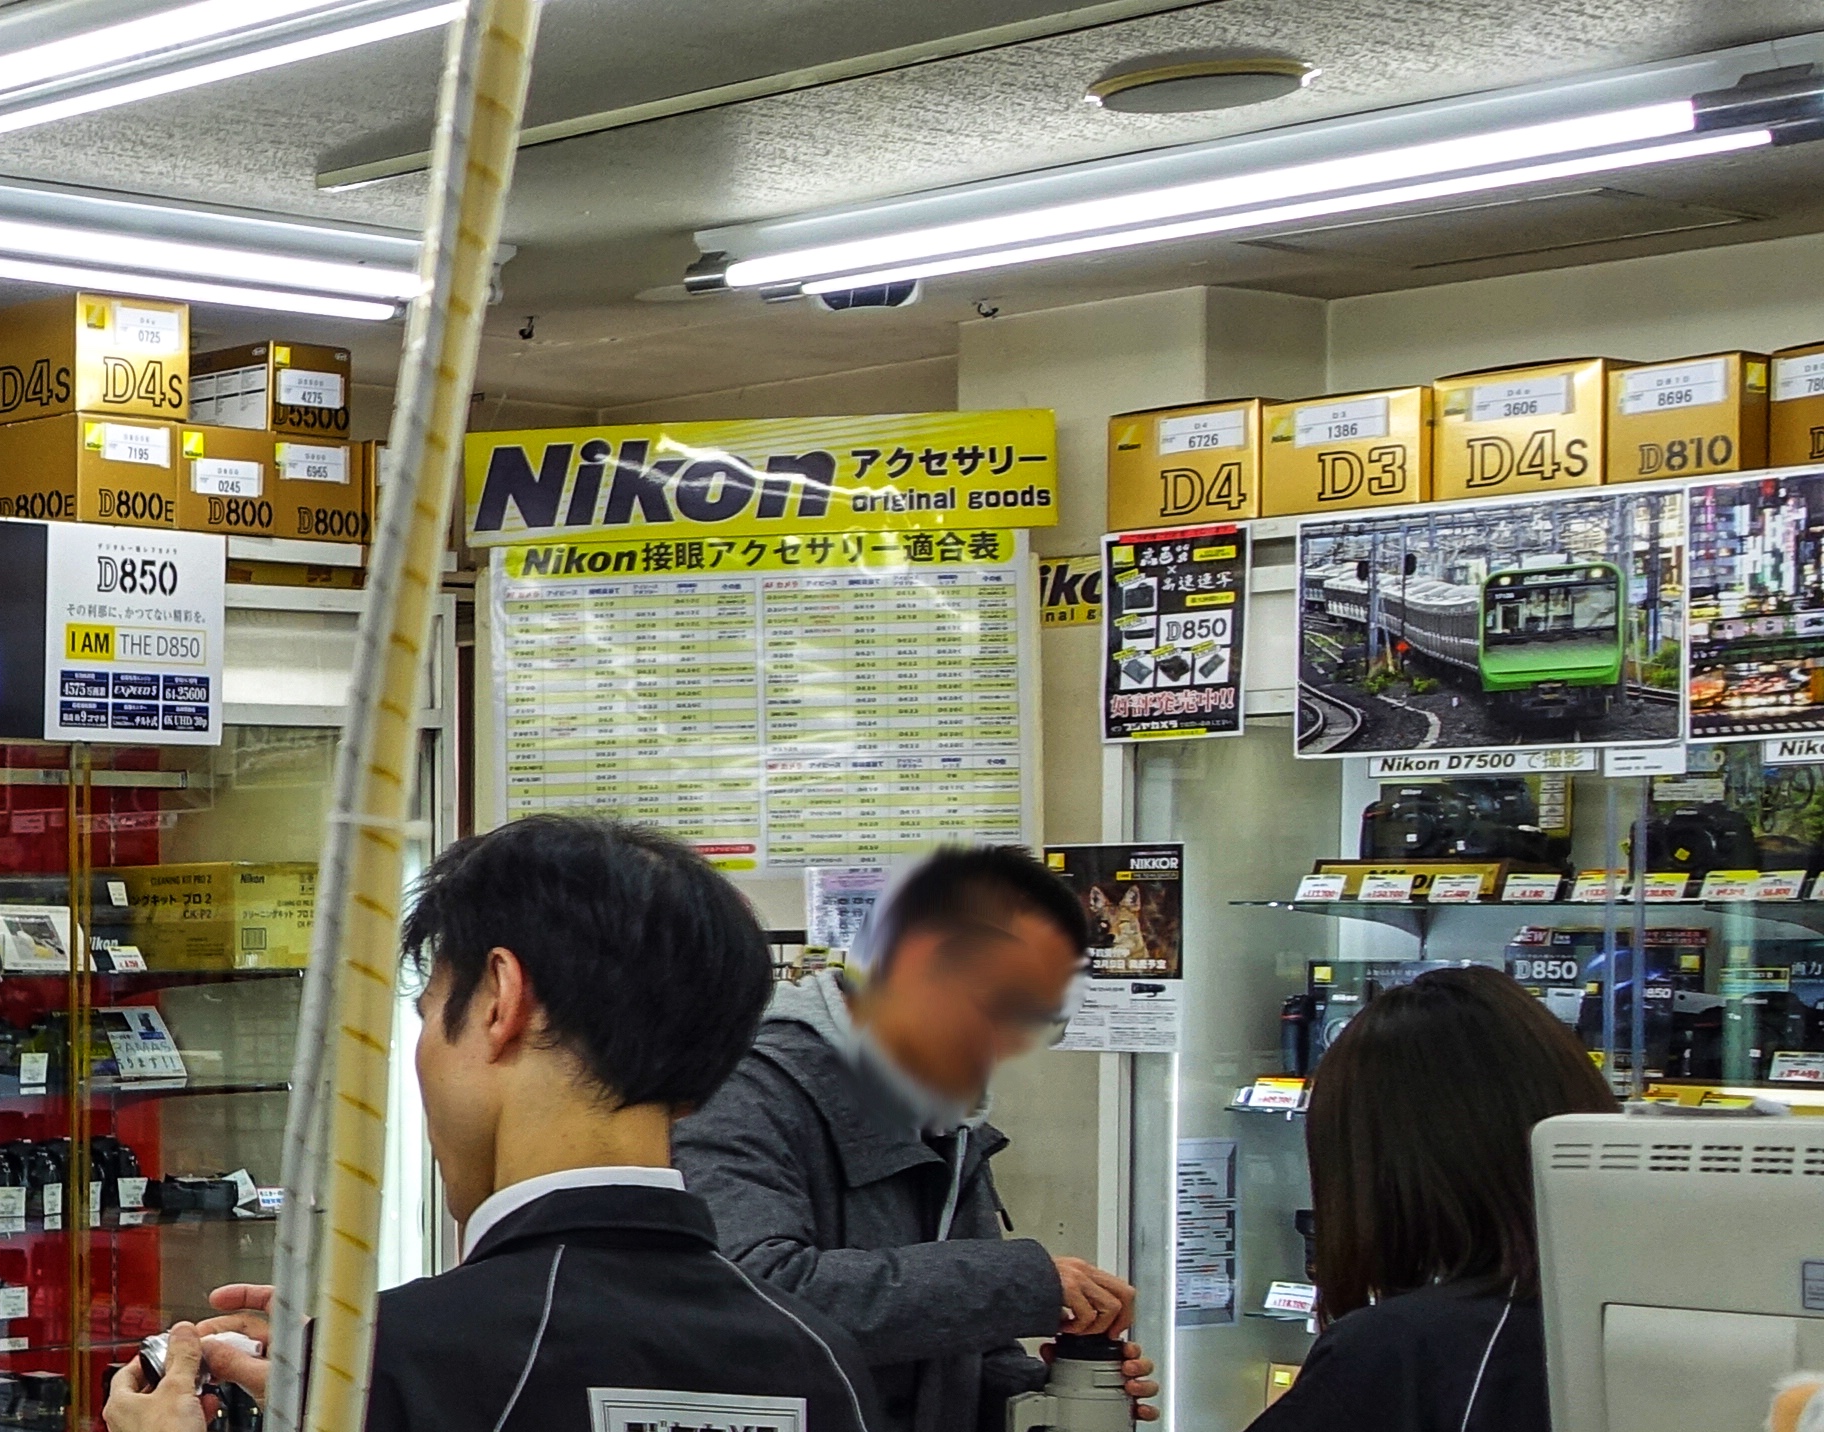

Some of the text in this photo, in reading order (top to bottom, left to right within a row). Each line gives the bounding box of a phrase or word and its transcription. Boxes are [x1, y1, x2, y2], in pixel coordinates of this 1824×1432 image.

[138, 330, 160, 344] 0725
[102, 357, 182, 408] D4s
[1502, 399, 1537, 416] 3606
[1657, 390, 1692, 406] 8696
[1187, 432, 1219, 449] 6726
[1325, 422, 1358, 439] 1386
[127, 446, 149, 460] 7195
[851, 446, 1048, 479] アクセサリー
[1466, 429, 1588, 487] D4s
[1637, 435, 1732, 474] D810
[217, 480, 240, 493] 0245
[473, 439, 837, 532] Nikon
[1317, 445, 1406, 501] D3
[851, 484, 1051, 512] original goods
[1160, 462, 1247, 517] D4
[98, 489, 174, 522] D800E
[208, 497, 272, 528] D800
[297, 507, 359, 537] D800
[96, 556, 178, 596] D850
[1165, 618, 1227, 641] D850
[70, 631, 200, 658] I AM THE D850
[1379, 750, 1584, 772] Nikon D7500 で撮影
[1129, 858, 1178, 869] NIKKOR
[239, 874, 265, 884] Nikon
[1514, 959, 1577, 980] D850
